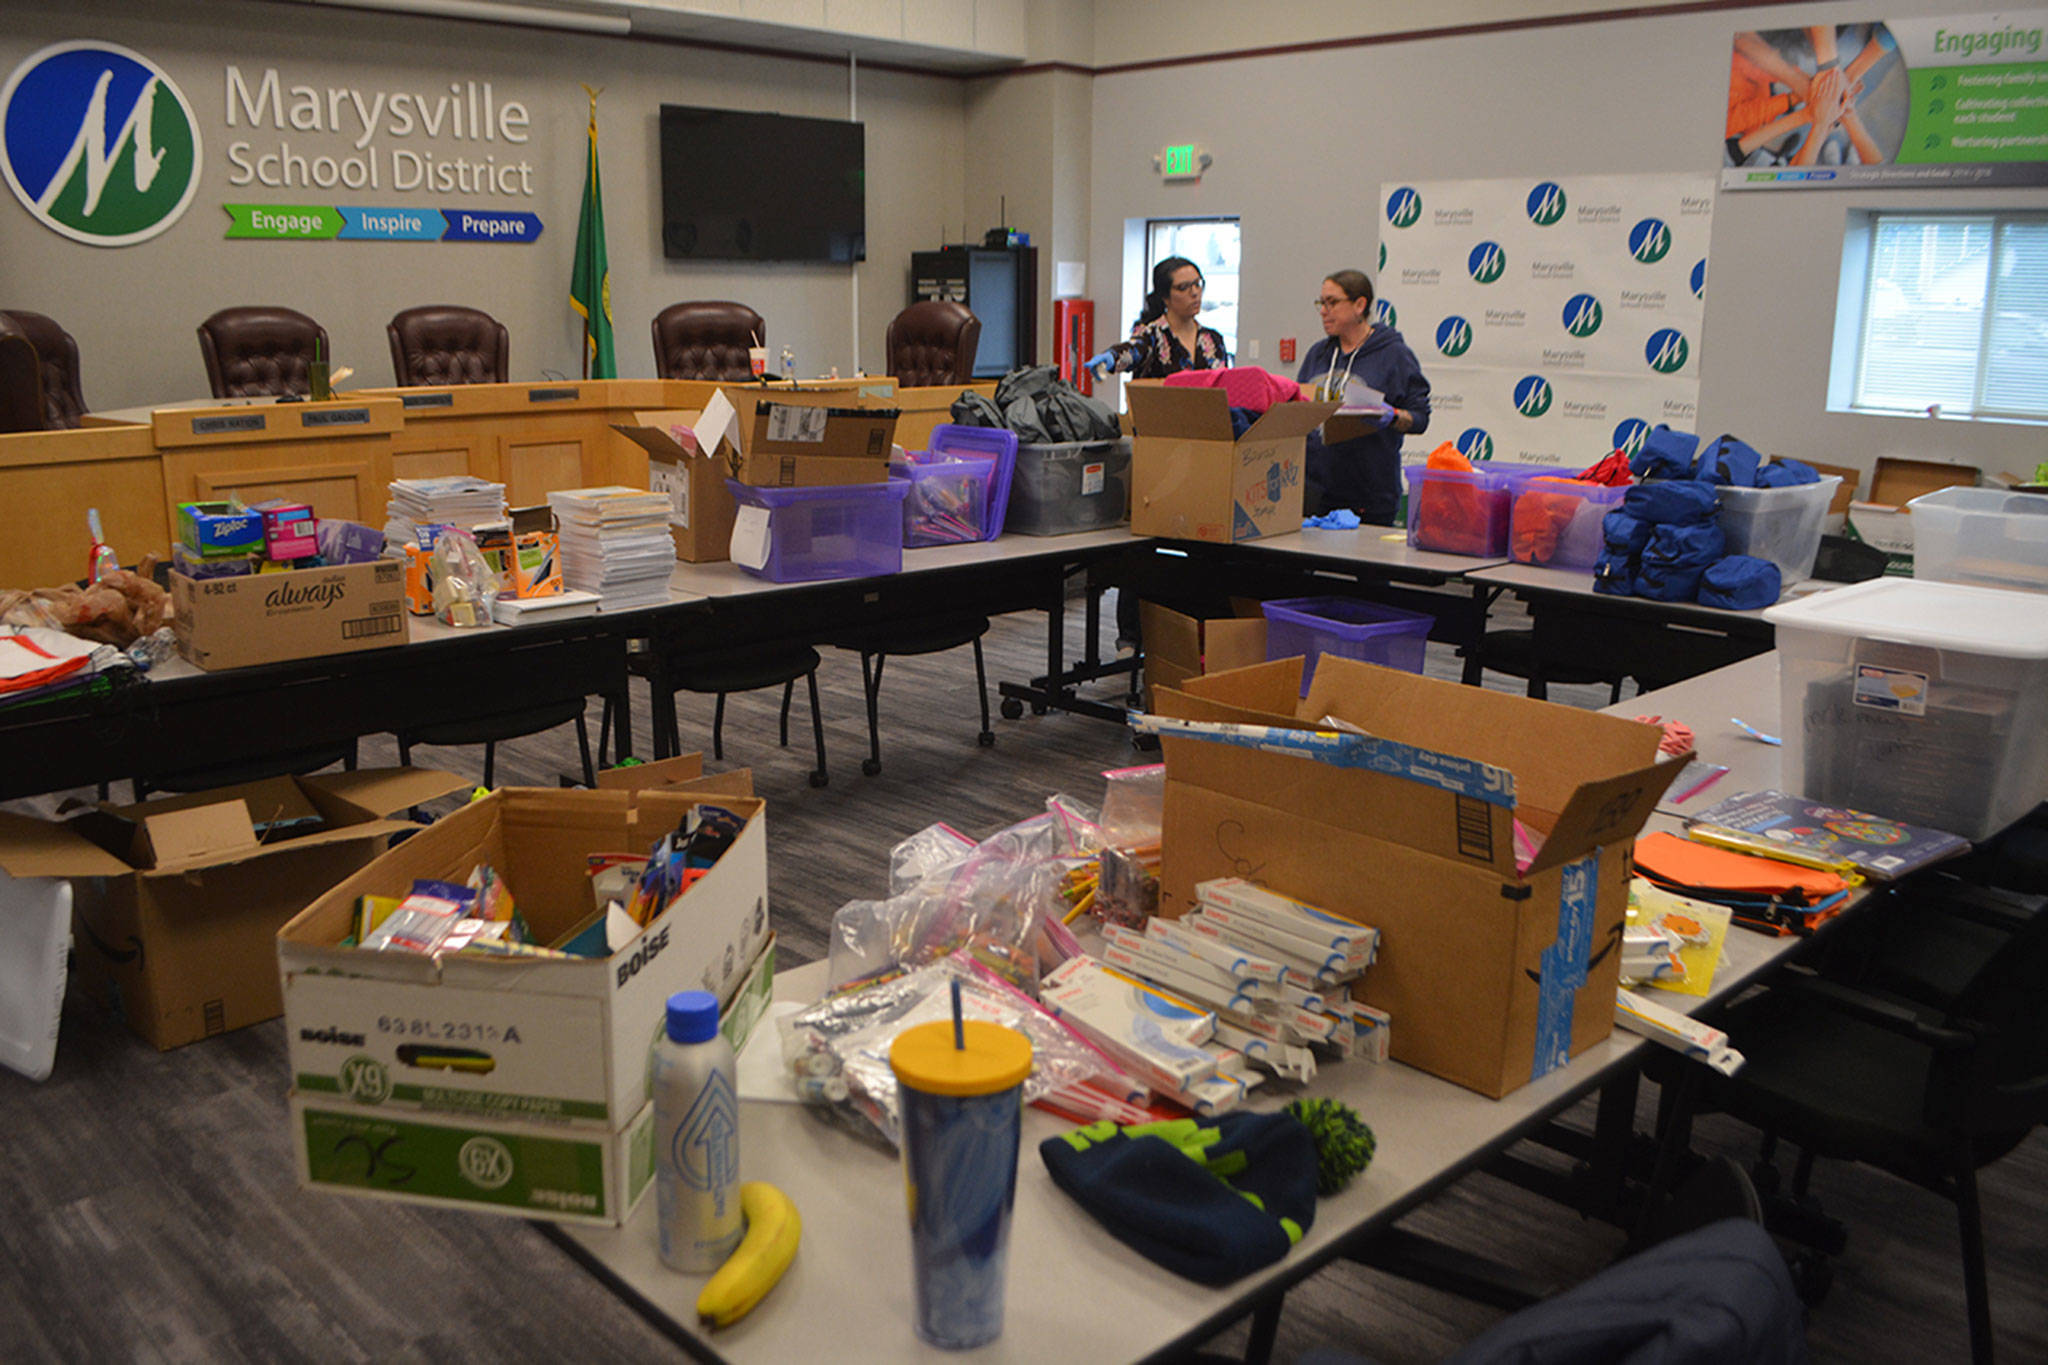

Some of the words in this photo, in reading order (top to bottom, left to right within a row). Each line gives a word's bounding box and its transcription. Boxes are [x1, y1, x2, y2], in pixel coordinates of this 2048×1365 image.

[1934, 25, 2043, 57] Engaging
[226, 65, 530, 150] Marysville
[228, 141, 379, 190] School
[392, 149, 534, 195] District
[1166, 144, 1194, 174] EXIT
[251, 209, 324, 235] Engage
[362, 212, 422, 235] Inspire
[462, 214, 526, 237] Prepare
[213, 518, 249, 538] Ziploc
[265, 581, 346, 610] always
[351, 1061, 383, 1100] X9
